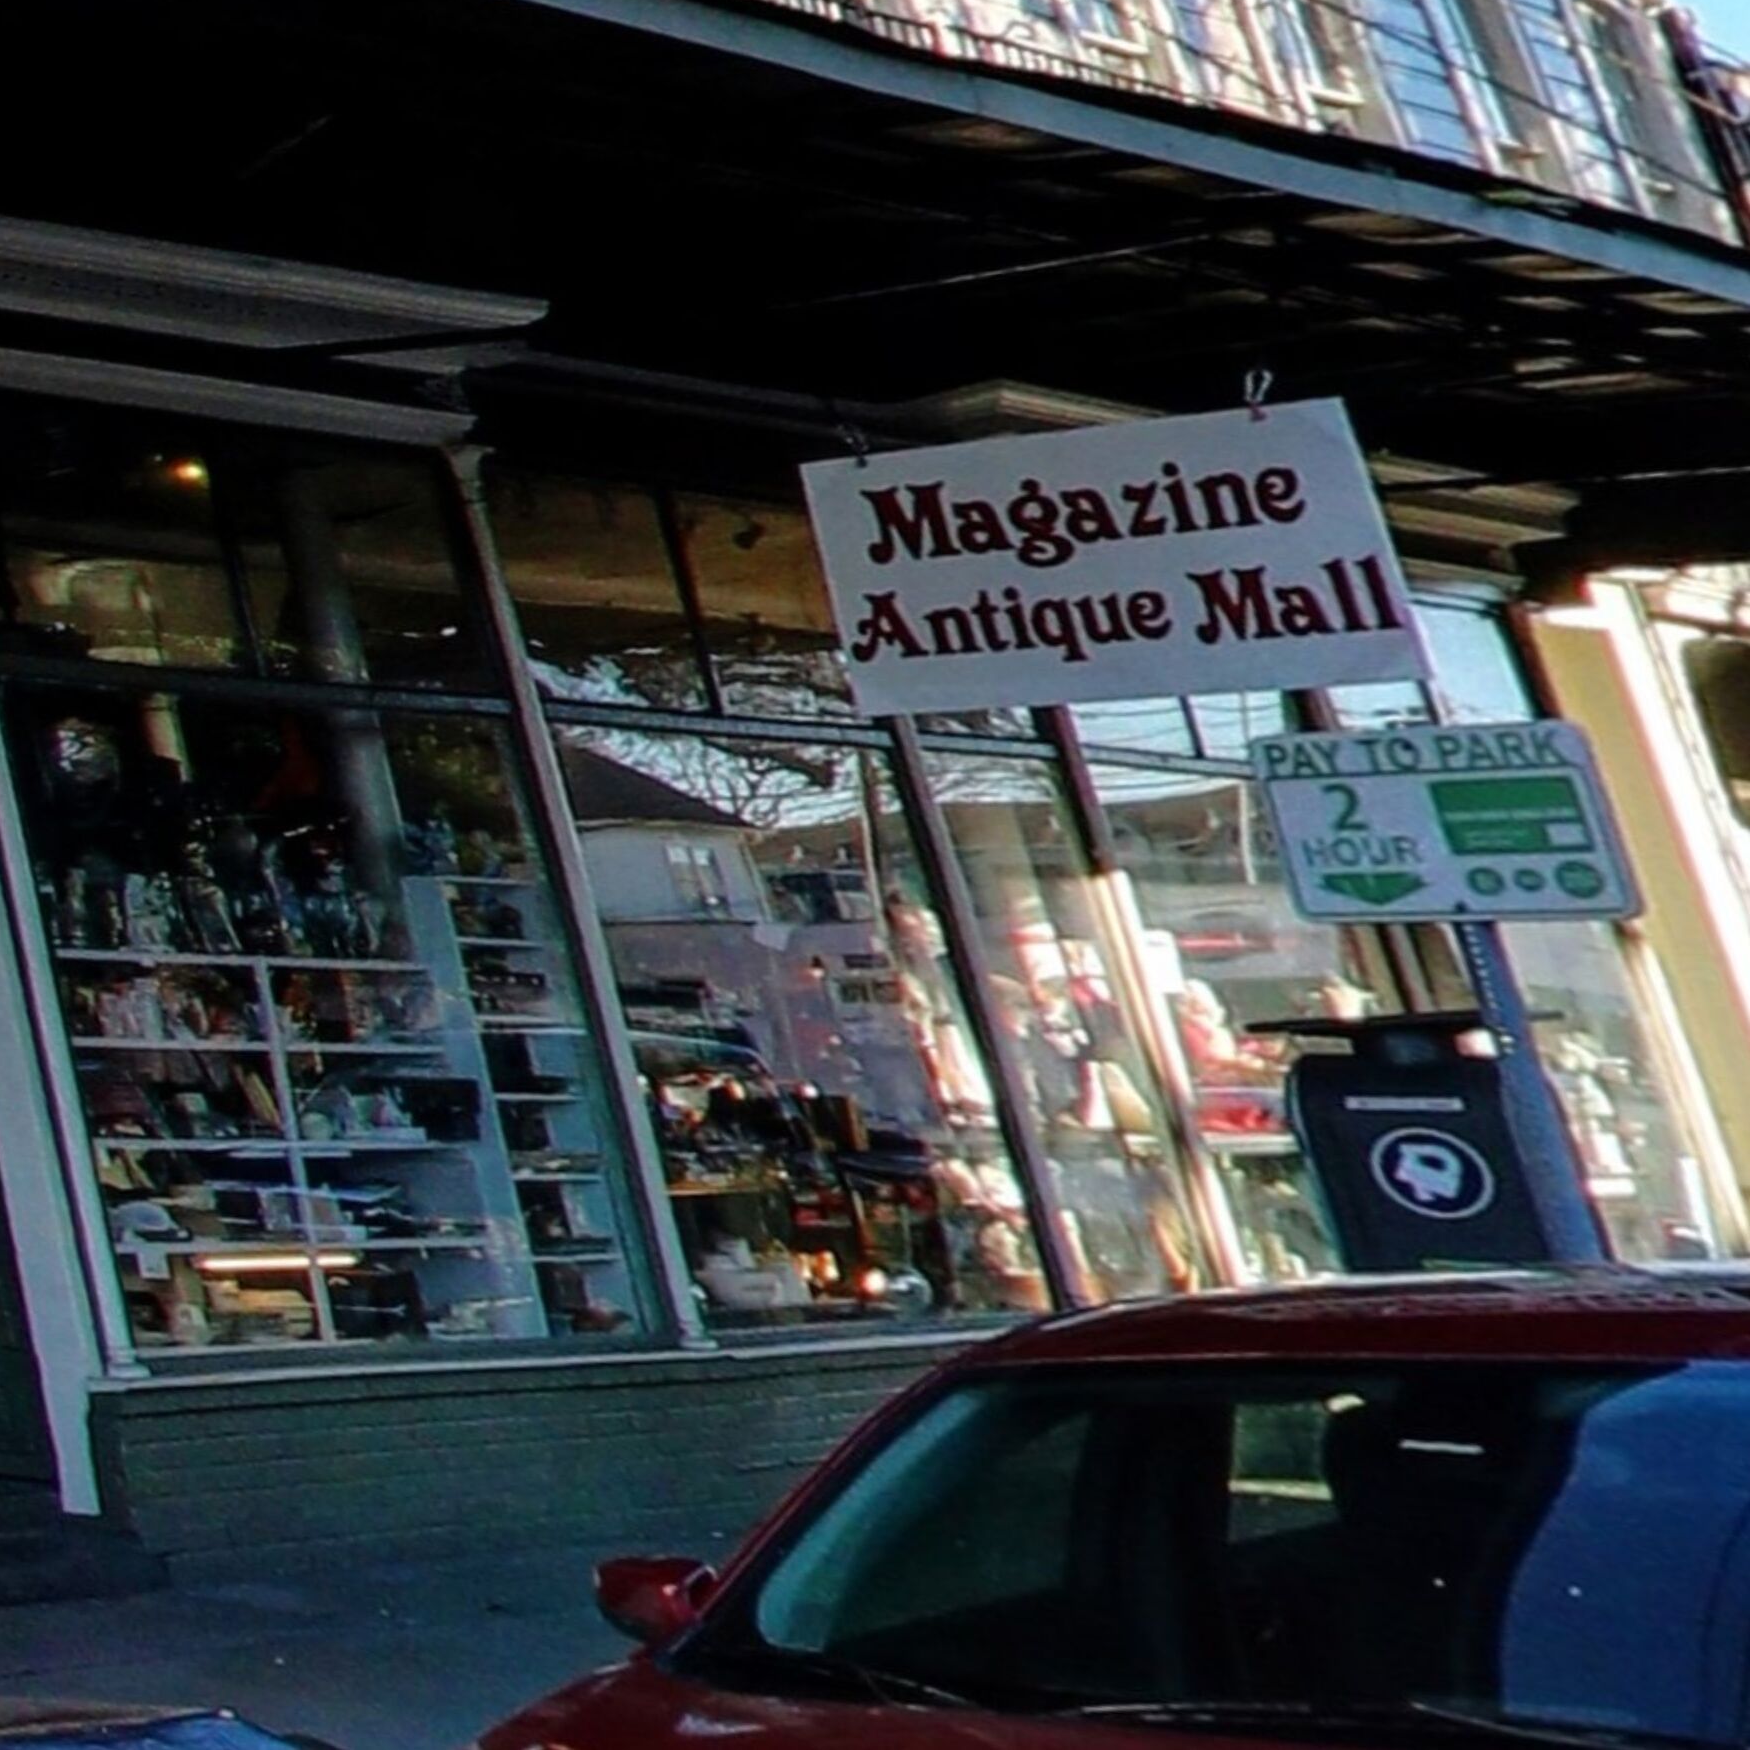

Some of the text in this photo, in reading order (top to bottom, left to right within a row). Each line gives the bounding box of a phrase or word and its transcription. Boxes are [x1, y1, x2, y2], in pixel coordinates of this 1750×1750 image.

[862, 461, 1307, 568] Magazine
[851, 554, 1405, 662] Antique Mall
[1264, 730, 1569, 777] PAY TO PARK
[1321, 783, 1371, 831] 2
[1301, 836, 1425, 867] HOUR
